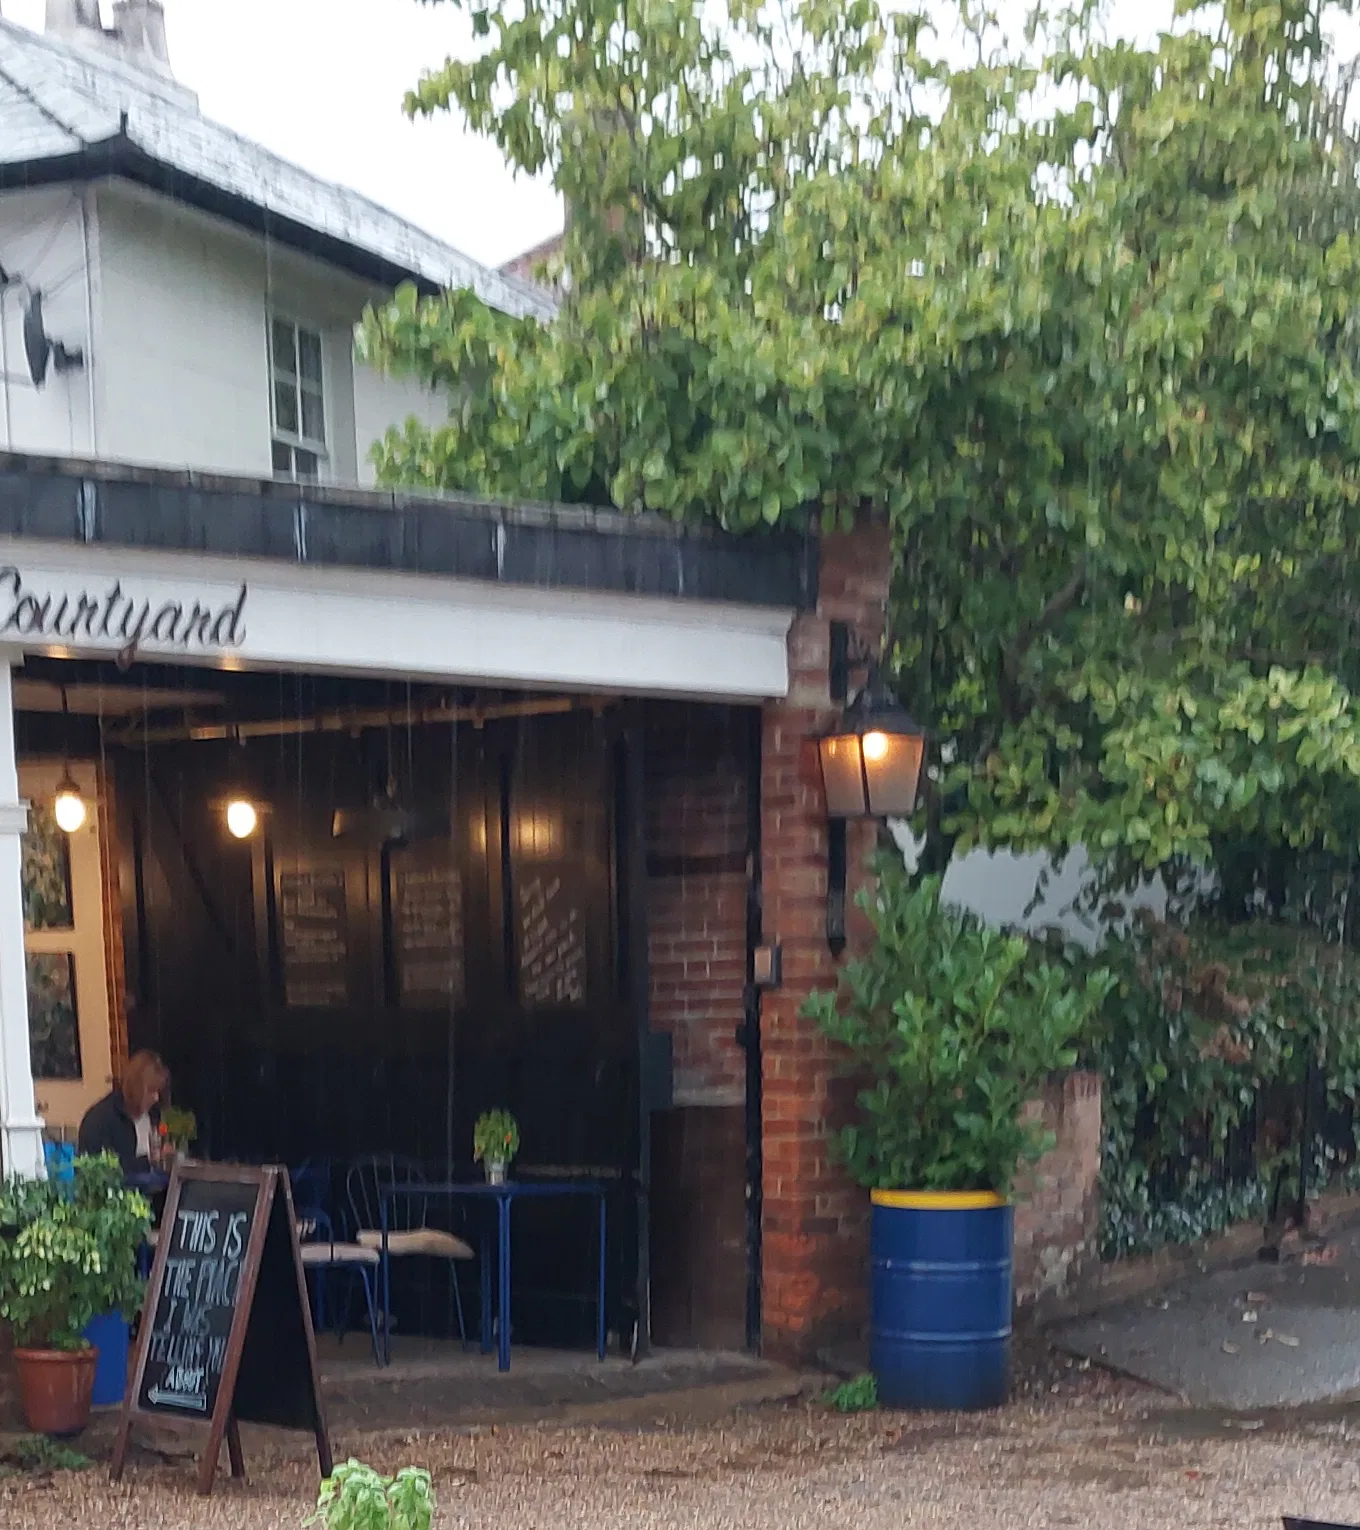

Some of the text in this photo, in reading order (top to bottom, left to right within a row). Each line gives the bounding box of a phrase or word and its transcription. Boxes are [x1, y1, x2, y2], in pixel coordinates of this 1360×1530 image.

[178, 1209, 248, 1260] THIS IS
[165, 1258, 196, 1298] THE
[165, 1366, 205, 1394] ABOUT
